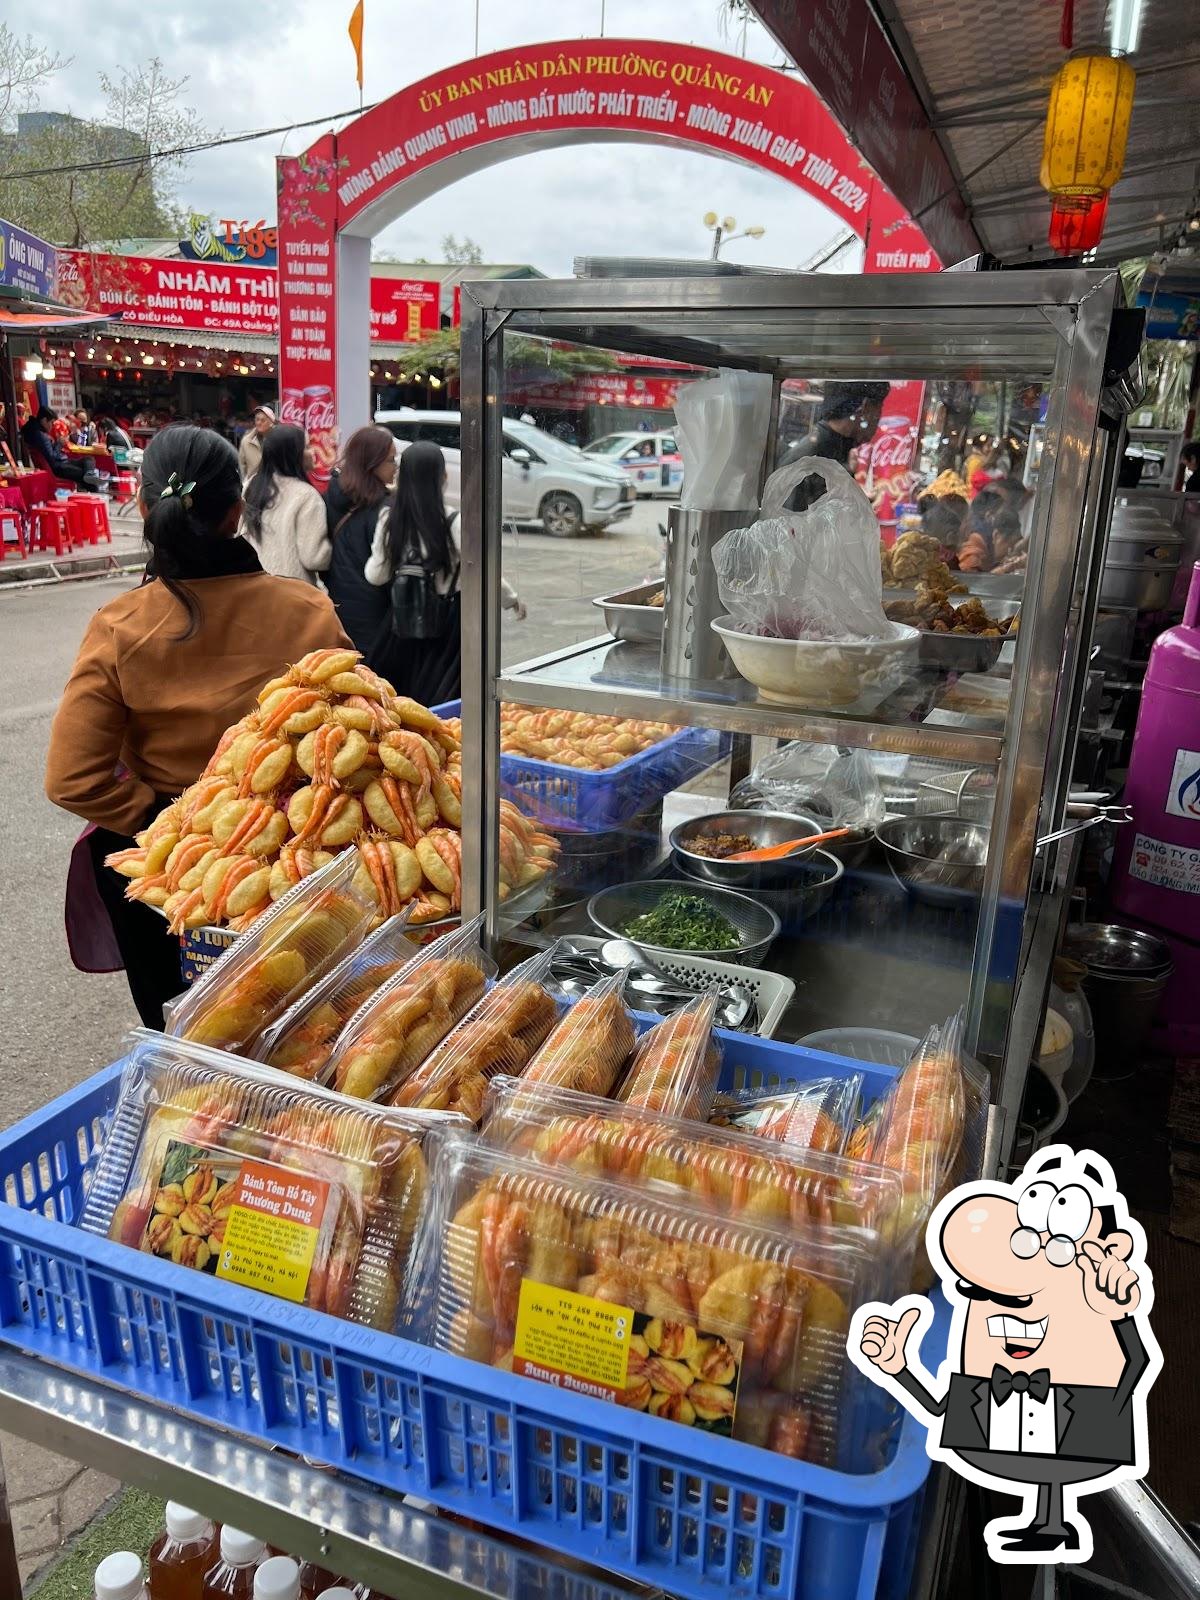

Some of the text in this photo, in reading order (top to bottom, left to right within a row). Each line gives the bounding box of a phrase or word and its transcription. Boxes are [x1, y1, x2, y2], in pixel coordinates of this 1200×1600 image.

[418, 52, 774, 113] ỦY BAN NHÂN DÂN PHƯỜNG QUẢNG AN
[338, 168, 374, 206] MỪNG
[372, 149, 407, 185] ĐẢNG
[404, 125, 447, 160] QUANG
[446, 112, 479, 141] VINH
[486, 98, 528, 128] MỪNG
[529, 87, 555, 120] ĐẤT
[557, 90, 595, 115] NƯỚC
[597, 88, 635, 115] PHÁT
[636, 88, 678, 122] TRIỂN
[686, 103, 730, 136] MỪNG
[730, 116, 772, 153] XUÂN
[769, 133, 806, 168] GIÁP
[801, 153, 839, 190] THÌN
[830, 175, 869, 213] 2024
[9, 232, 26, 264] ÔNG
[27, 245, 45, 273] VINH
[220, 218, 278, 259] Tige
[285, 239, 311, 257] TUYẾN
[307, 262, 328, 276] MINH
[876, 248, 932, 269] TUYẾN PHỐ
[158, 269, 279, 298] NHÂM THÌ
[100, 289, 123, 304] BÚN
[147, 292, 179, 309] BÁNH
[180, 296, 204, 312] TÔM
[211, 298, 240, 315] BÁNH
[242, 301, 263, 319] BỘT
[291, 327, 304, 340] AN
[304, 326, 326, 342] TOÀN
[305, 401, 335, 429] Cola
[871, 433, 912, 468] Cola
[1171, 849, 1186, 859] TY
[191, 929, 202, 943] 4
[242, 1173, 265, 1190] Bánh
[266, 1179, 286, 1196] Tôm
[300, 1189, 317, 1205] Tây
[282, 1202, 313, 1224] Dung
[524, 1361, 561, 1386] Dung
